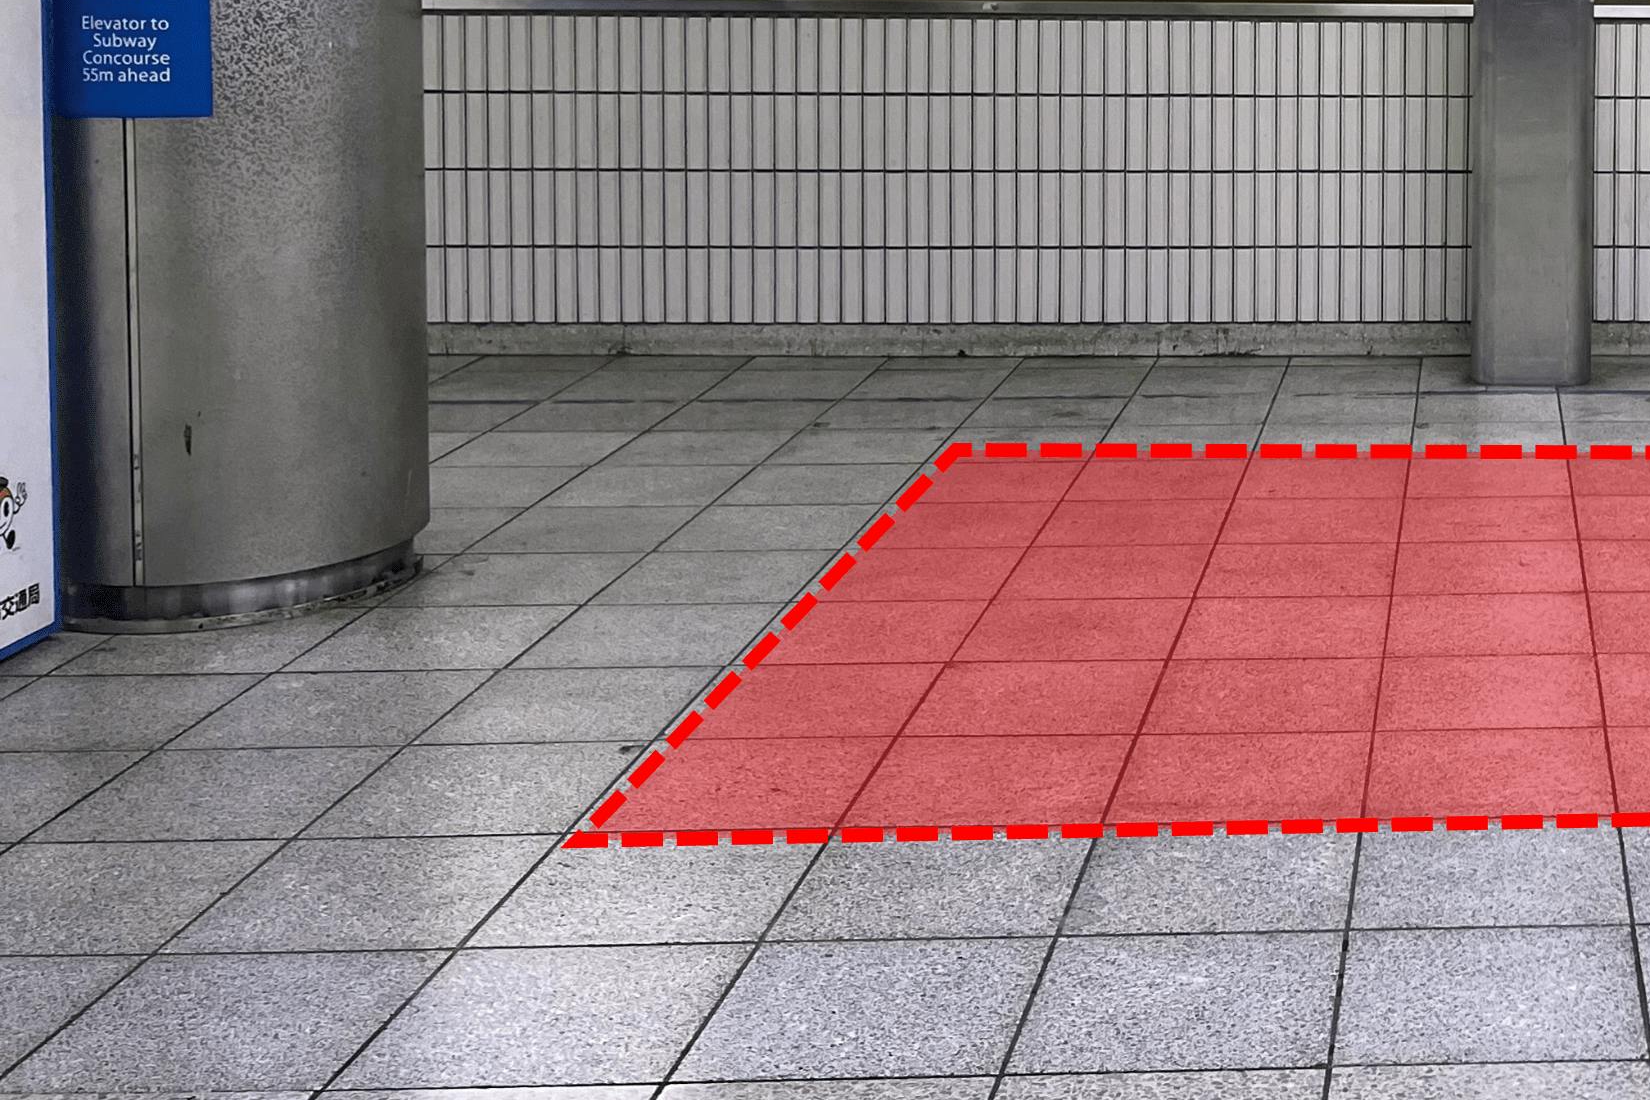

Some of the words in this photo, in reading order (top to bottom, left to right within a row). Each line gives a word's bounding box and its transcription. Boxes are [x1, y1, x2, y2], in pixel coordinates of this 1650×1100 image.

[82, 16, 147, 30] Elevator
[151, 17, 169, 30] to
[93, 33, 157, 51] Subway
[83, 50, 171, 65] Concourse
[82, 68, 114, 82] 55m
[118, 68, 171, 82] ahead
[0, 583, 40, 620] 交通局
